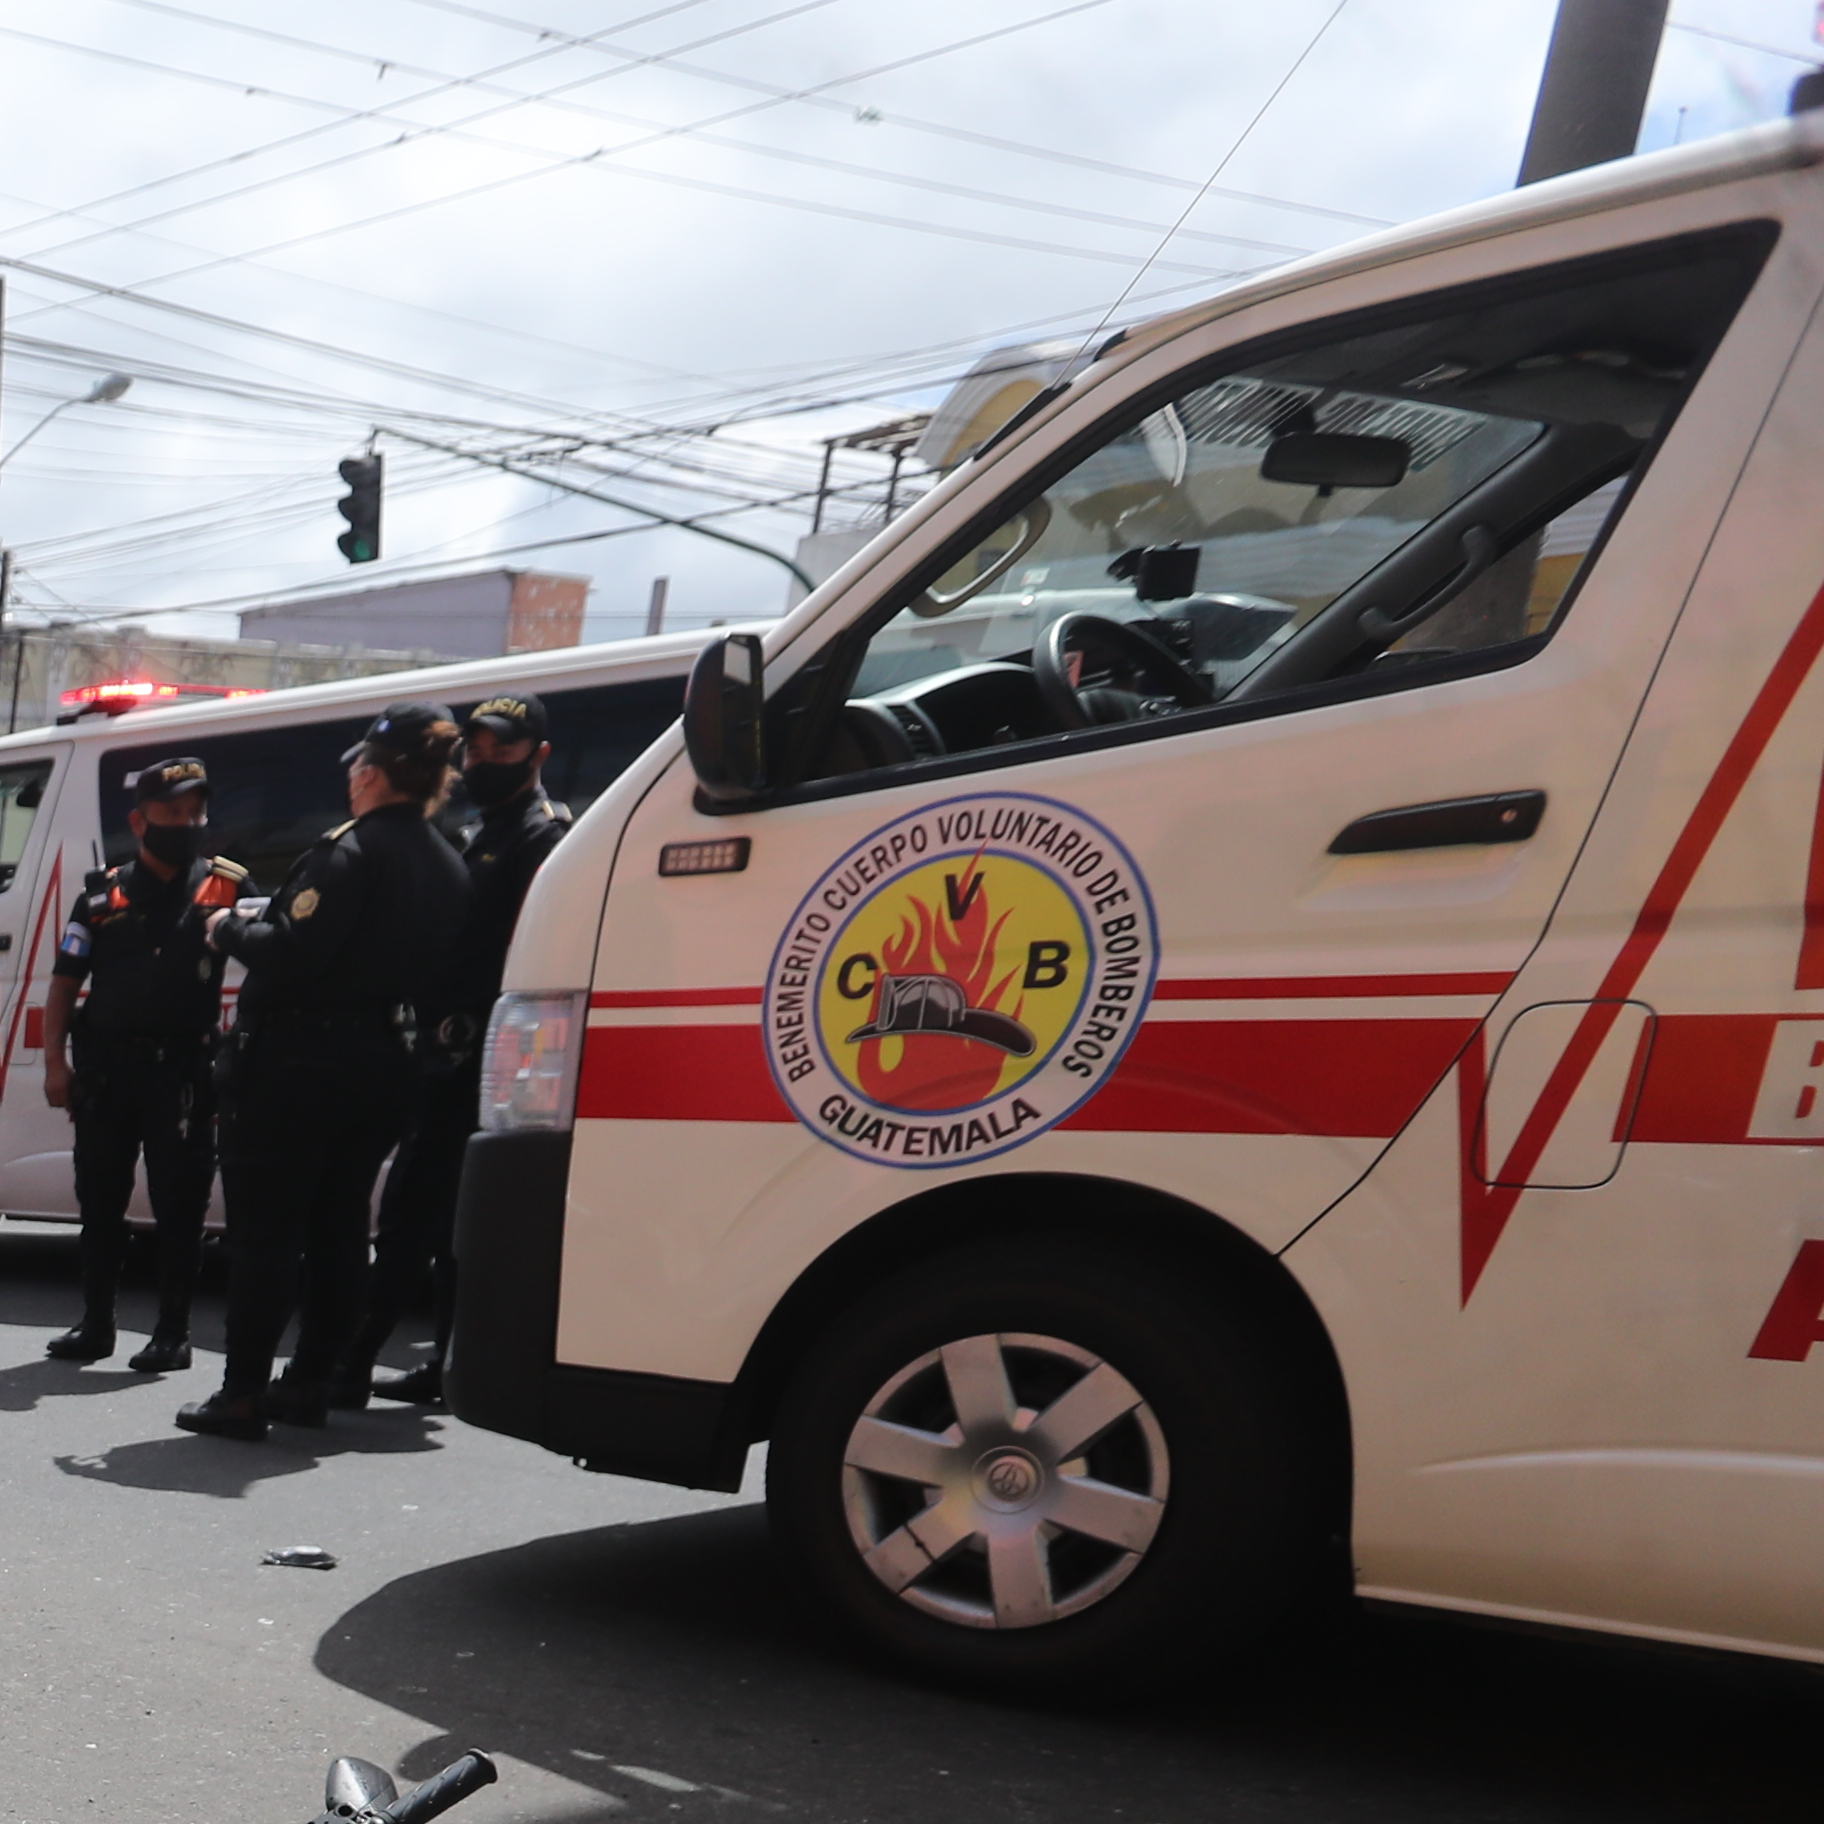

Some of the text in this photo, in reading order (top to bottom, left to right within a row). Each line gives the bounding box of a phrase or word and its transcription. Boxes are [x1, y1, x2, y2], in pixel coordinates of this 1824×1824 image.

[777, 808, 1141, 1082] BENEMERITO CUERPO VOLUNTARIO DE BOMBEROS
[836, 871, 1071, 1000] C V B
[818, 1093, 1042, 1157] GUATEMALA
